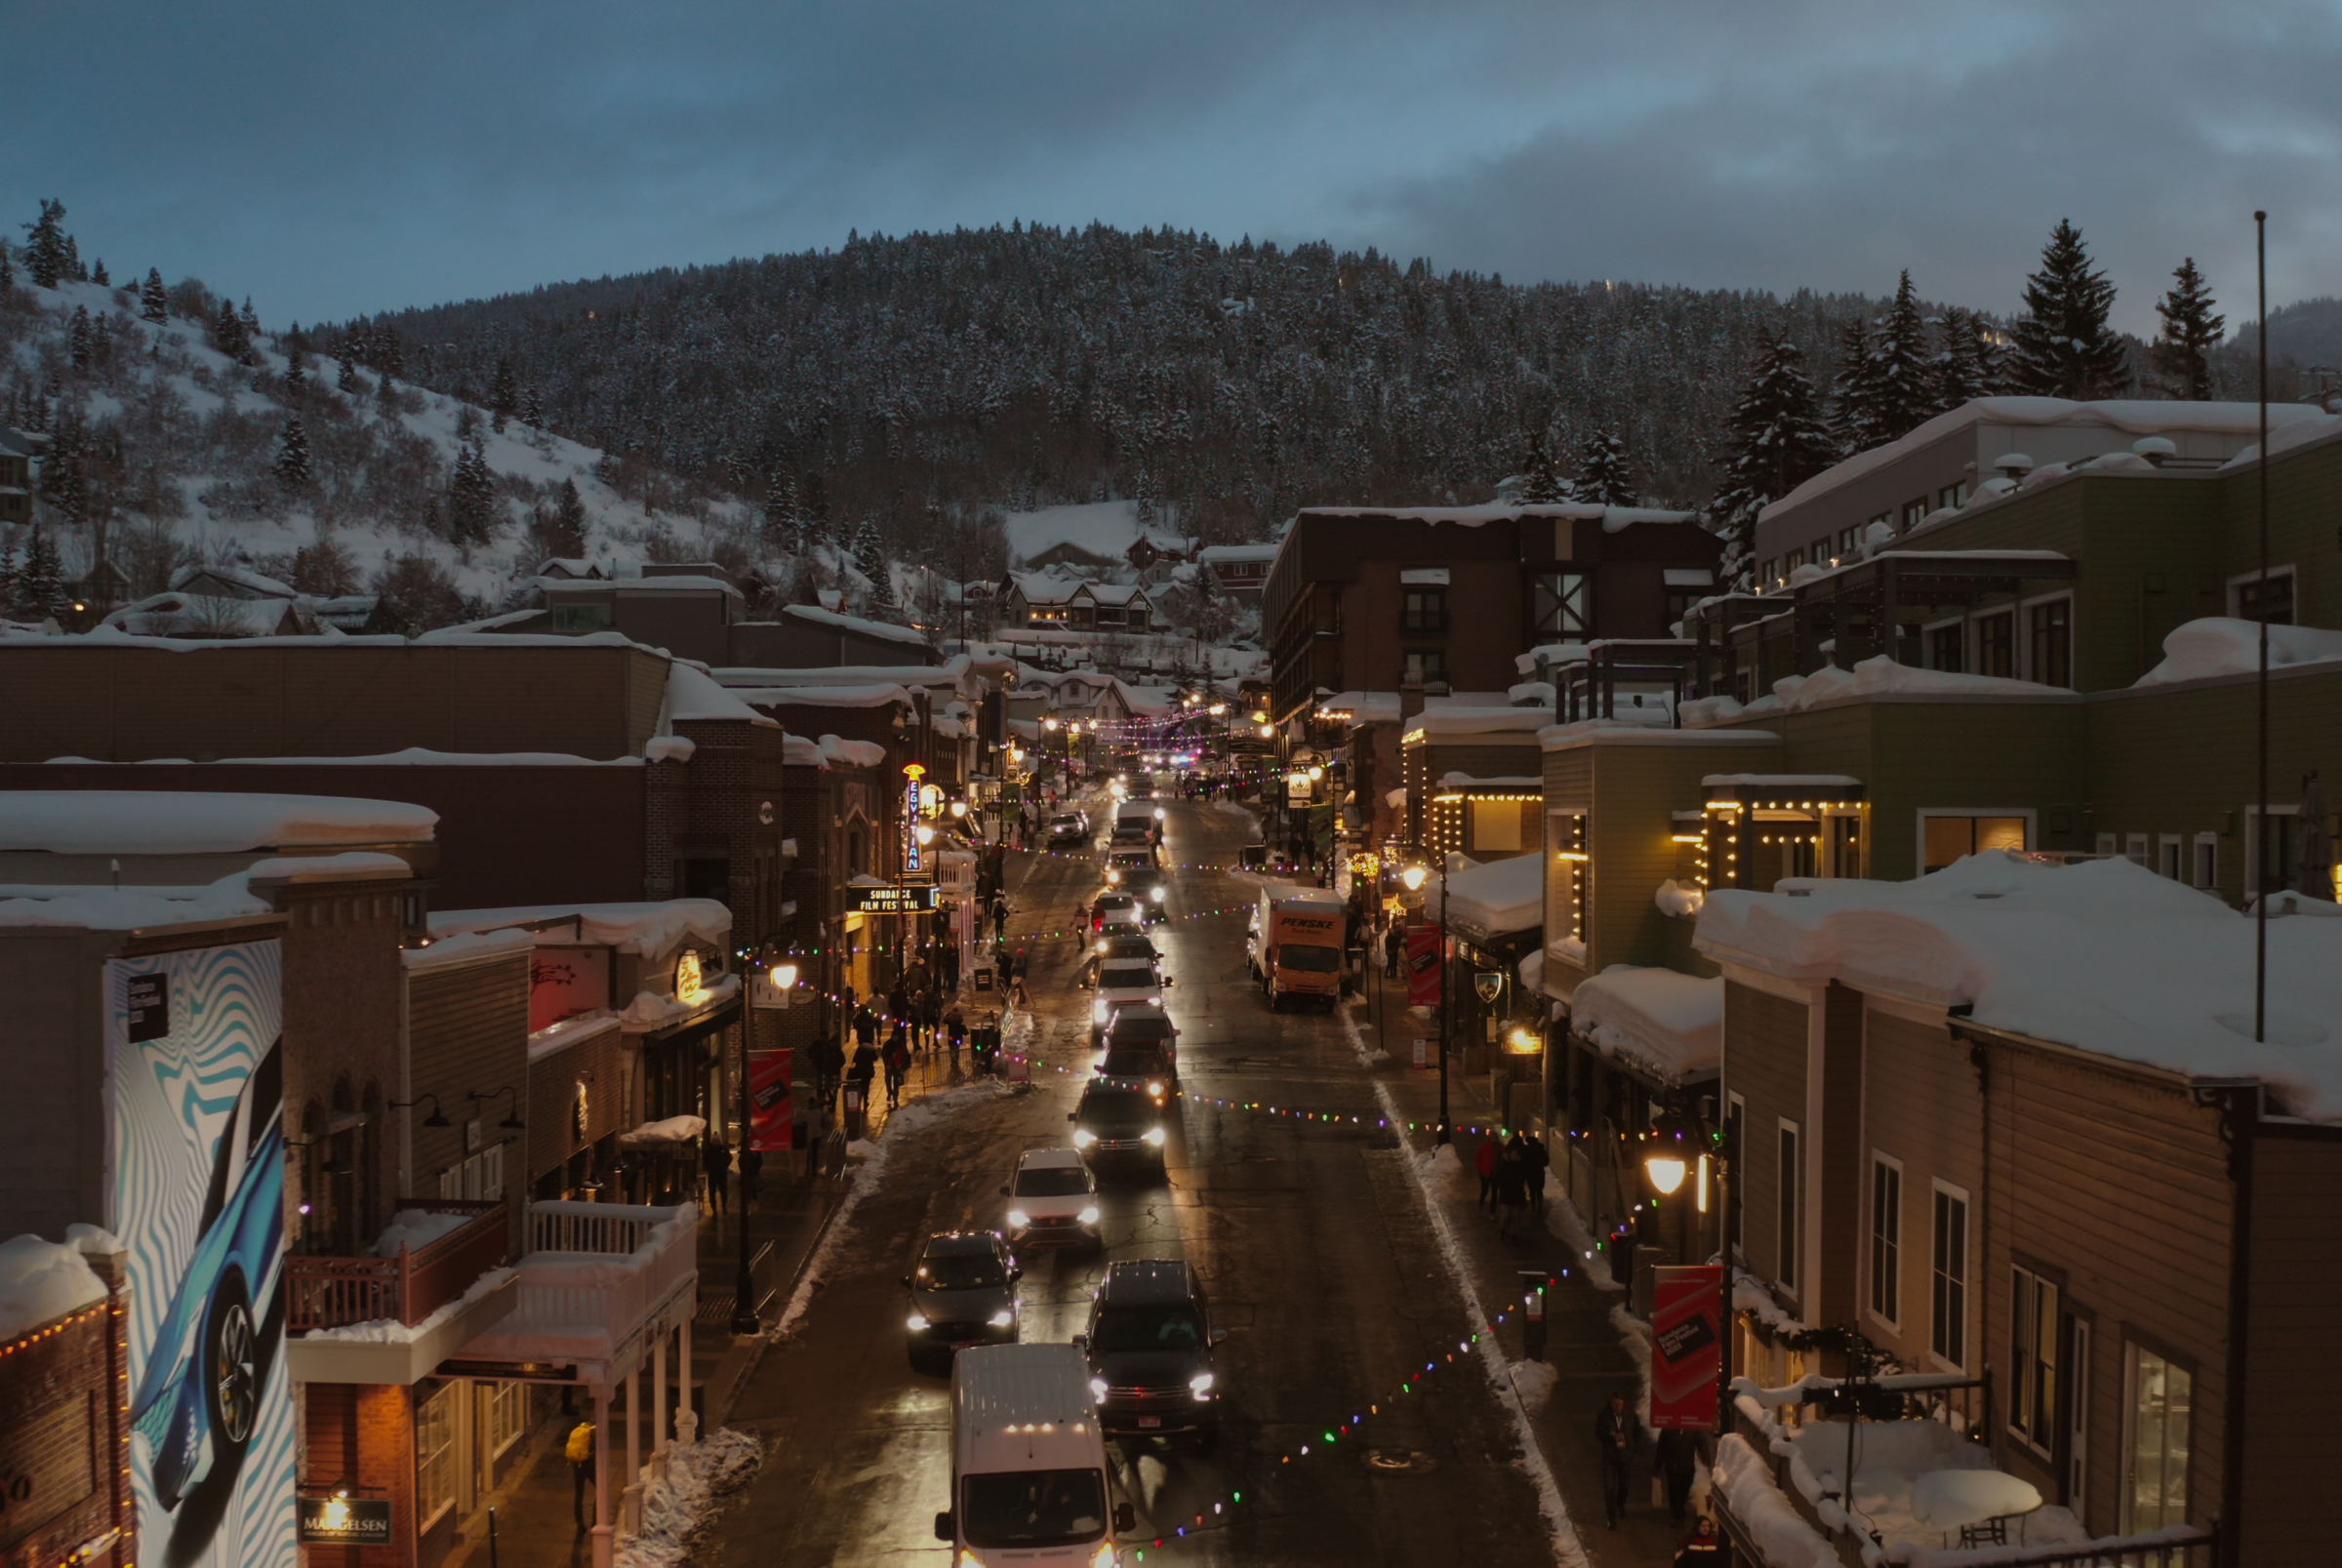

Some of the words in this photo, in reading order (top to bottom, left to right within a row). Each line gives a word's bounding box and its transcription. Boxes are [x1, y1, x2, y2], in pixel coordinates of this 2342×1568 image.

[860, 901, 879, 910] FILM
[882, 900, 919, 910] FESVAL
[1280, 917, 1336, 929] PENSKE
[1657, 1324, 1690, 1344] Sundance
[1661, 1339, 1676, 1350] Film
[1675, 1324, 1699, 1342] Festival
[1665, 1342, 1682, 1356] 2023
[303, 1516, 387, 1531] MAGELSEN
